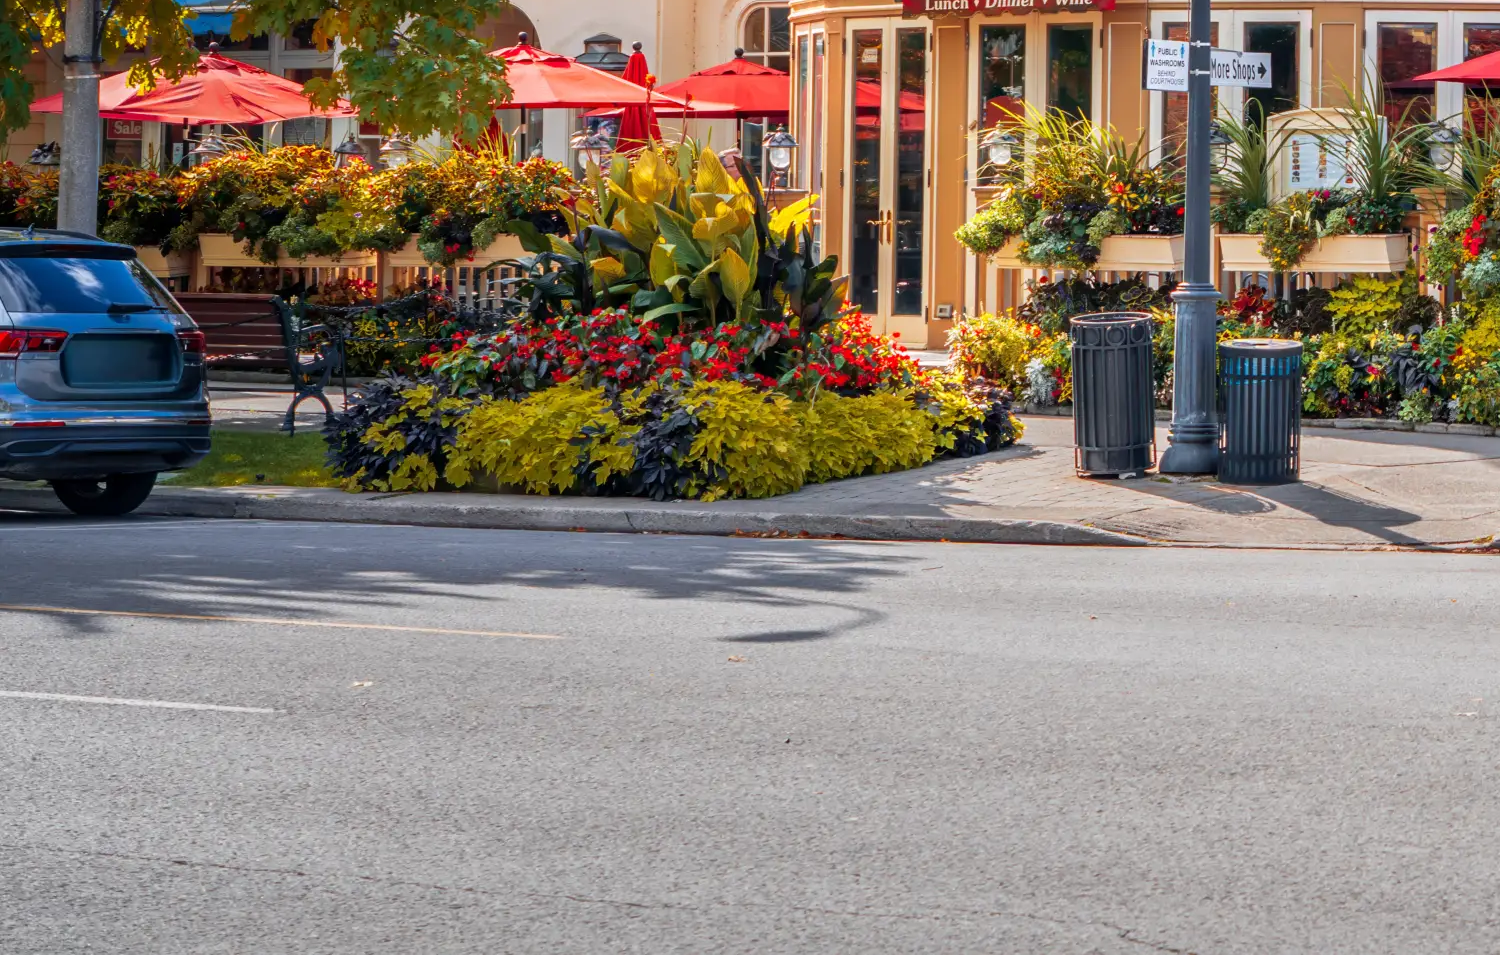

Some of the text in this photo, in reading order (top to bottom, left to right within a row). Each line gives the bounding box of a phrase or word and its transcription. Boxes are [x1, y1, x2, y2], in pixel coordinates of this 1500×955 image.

[1157, 47, 1178, 56] PUBLIC
[1150, 59, 1185, 67] WASHROOMS
[1211, 58, 1256, 85] More Shops
[1150, 77, 1185, 85] COURTHOUSE
[114, 120, 142, 135] Sale
